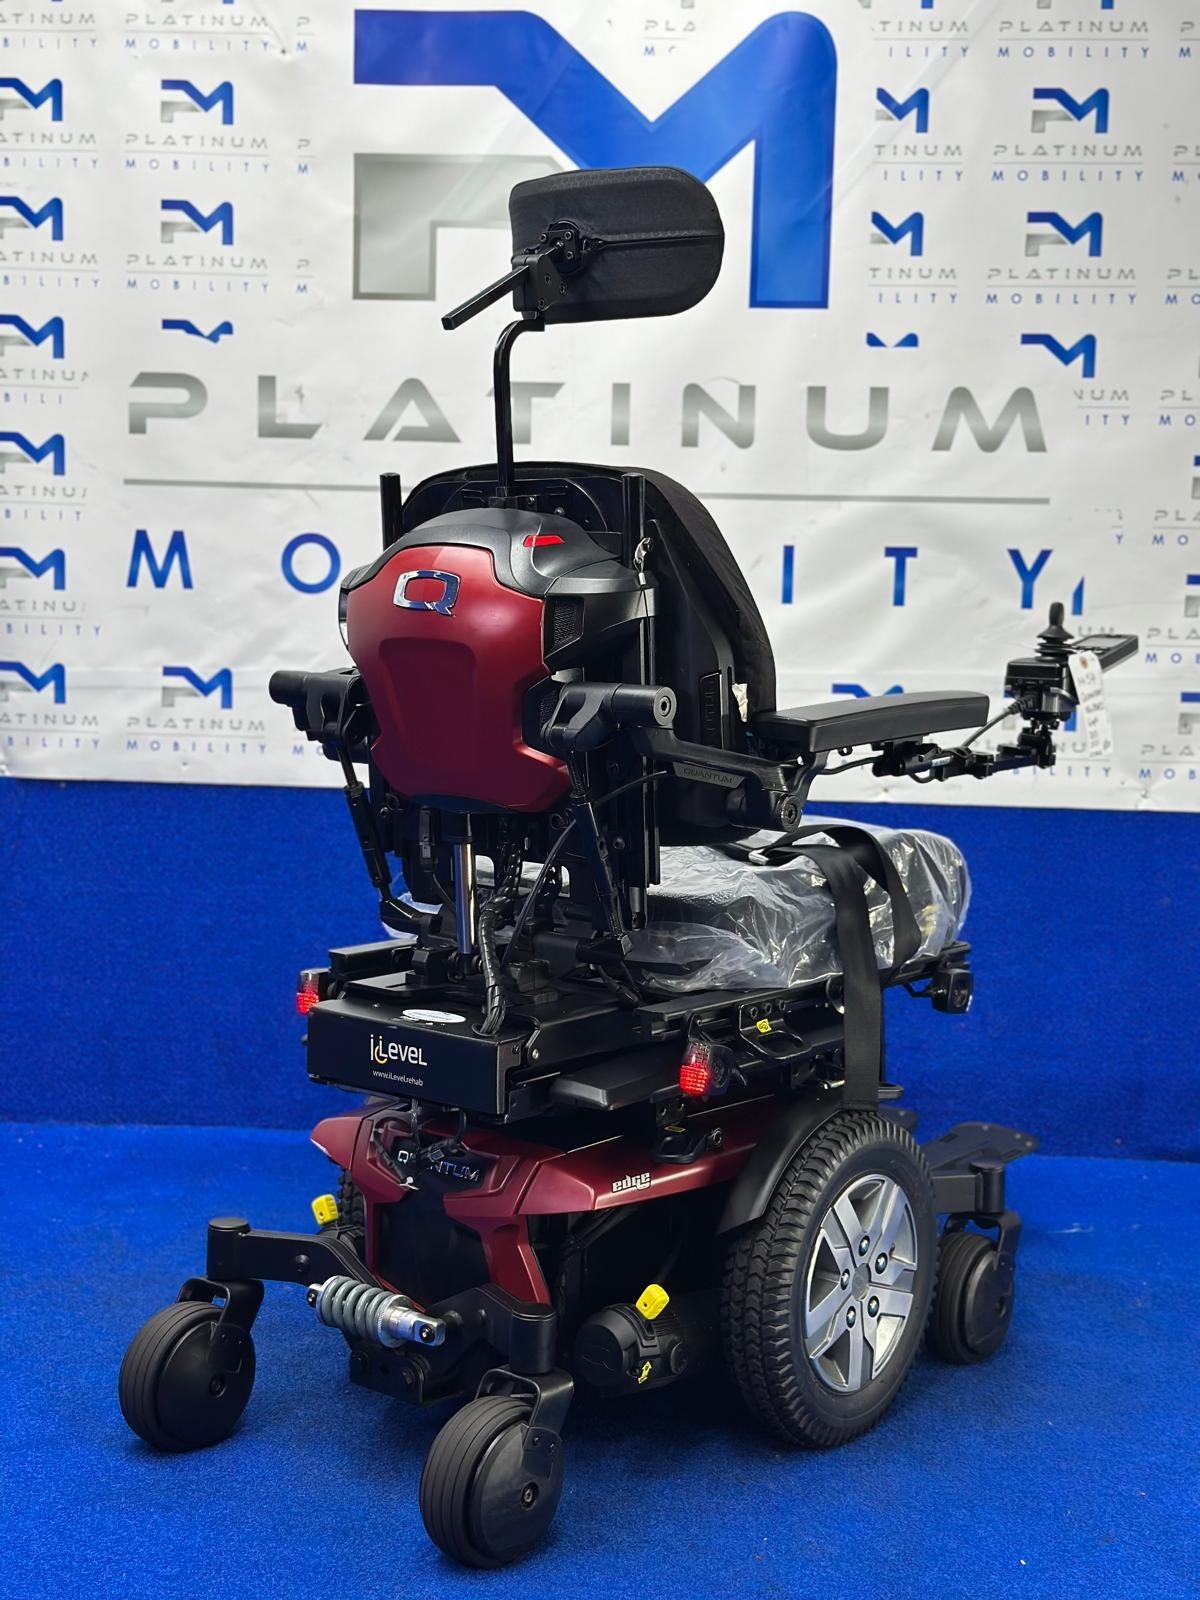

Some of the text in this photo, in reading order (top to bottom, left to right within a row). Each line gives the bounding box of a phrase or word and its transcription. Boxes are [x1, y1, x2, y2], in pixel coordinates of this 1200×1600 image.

[124, 12, 269, 27] PLATINUM
[999, 20, 1149, 33] PLATINUM
[125, 38, 269, 51] MOBILITY
[997, 45, 1150, 59] MOBILITY
[124, 133, 268, 149] PLATINUM
[993, 144, 1144, 157] PLATINUM
[125, 158, 270, 172] MOBILITY
[991, 169, 1144, 183] MOBILITY
[126, 253, 268, 269] PLATINUM
[987, 267, 1137, 281] PLATINUM
[126, 278, 268, 292] MOBILITY
[985, 292, 1137, 305] MOBILITY
[128, 371, 1047, 452] PLATINUM
[393, 570, 461, 615] Q
[127, 716, 265, 731] PLATINUM
[126, 740, 266, 754] MOBILITY
[611, 1171, 651, 1193] edge
